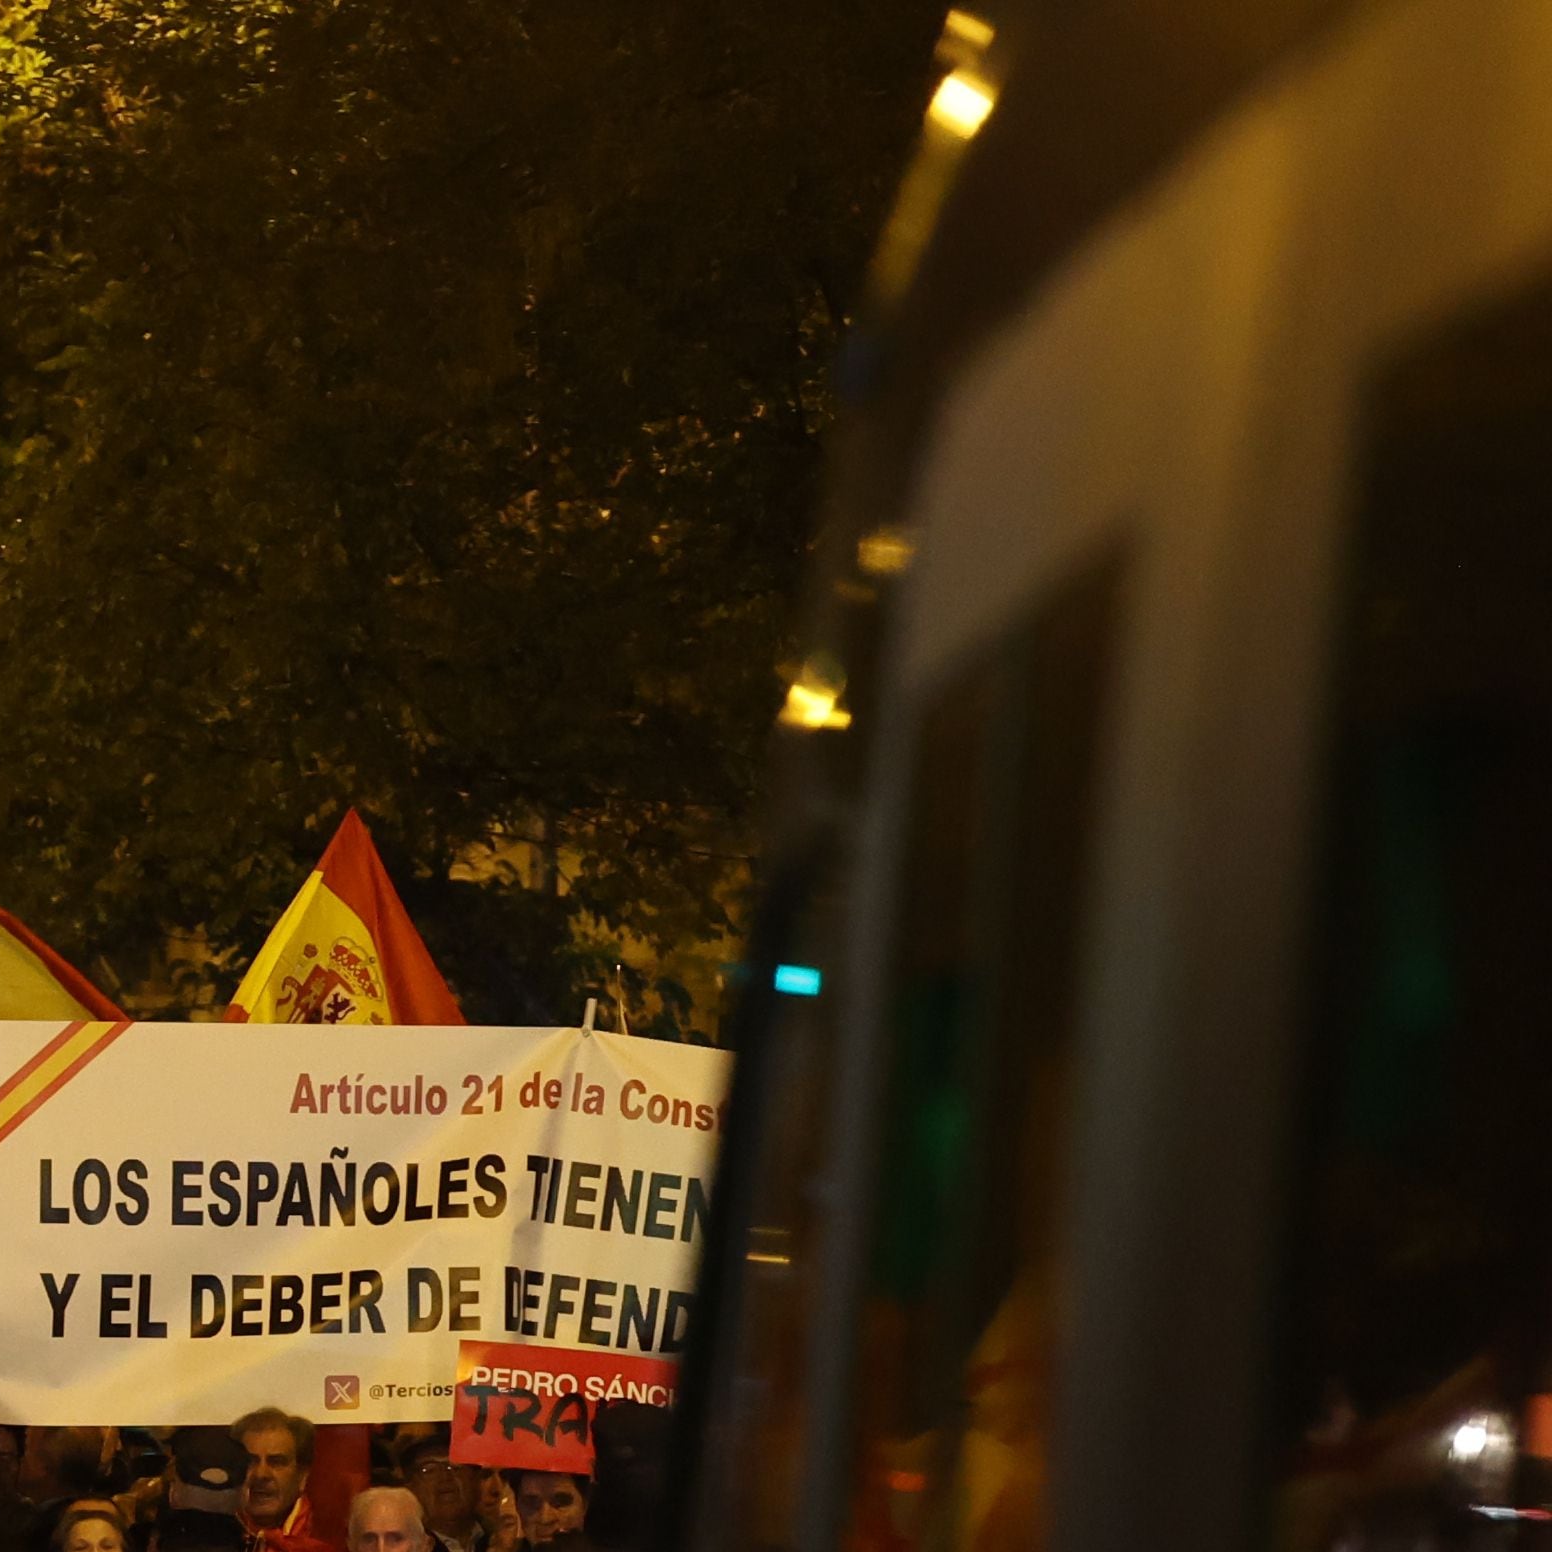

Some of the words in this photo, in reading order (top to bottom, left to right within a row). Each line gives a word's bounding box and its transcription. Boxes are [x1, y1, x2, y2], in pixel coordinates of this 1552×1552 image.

[290, 1072, 448, 1116] Artículo
[461, 1074, 503, 1116] 21
[519, 1070, 562, 1110] de
[571, 1071, 605, 1116] la
[39, 1157, 149, 1226] LOS
[171, 1145, 509, 1228] ESPAÑOLES
[39, 1272, 81, 1338] Y
[99, 1273, 169, 1339] EL
[189, 1268, 387, 1339] DEBER
[407, 1266, 481, 1334] DE
[505, 1265, 695, 1354] DEFEND
[463, 1385, 597, 1449] TRA
[471, 1365, 578, 1398] PEDRO
[584, 1373, 678, 1409] SÁNC
